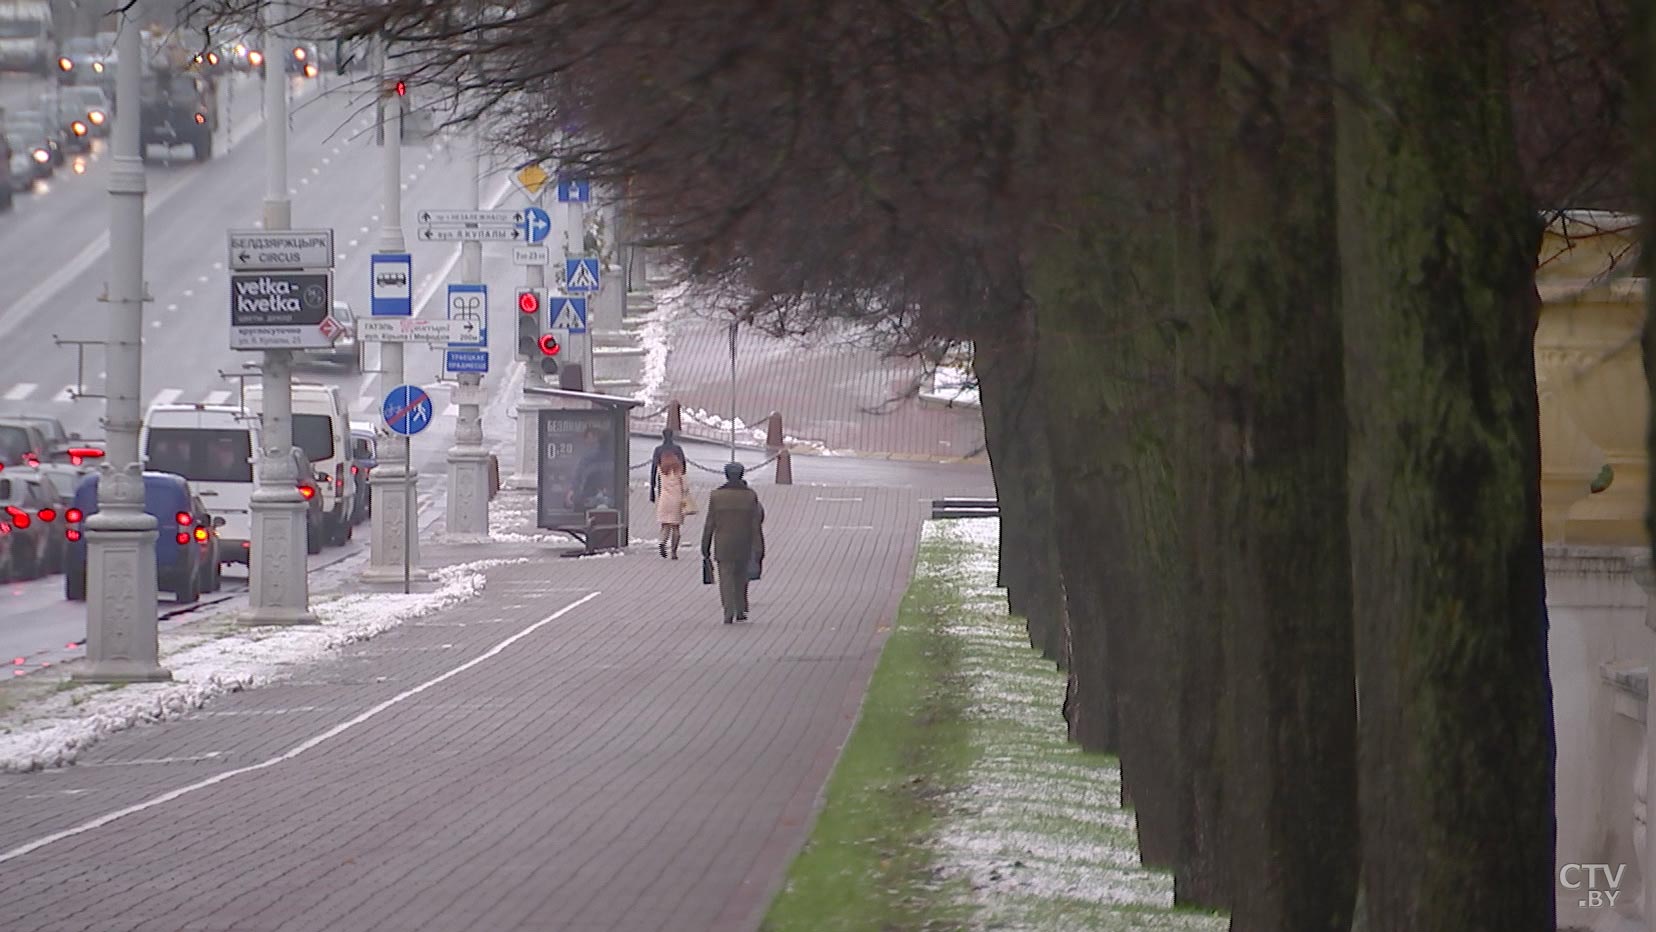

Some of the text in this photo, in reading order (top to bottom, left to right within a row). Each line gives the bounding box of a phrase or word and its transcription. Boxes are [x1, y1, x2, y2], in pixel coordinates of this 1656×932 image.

[231, 238, 326, 249] БЕЛДЗЯРЖЦЫРК
[258, 252, 301, 262] CIRCUS
[236, 277, 299, 295] vetka-
[237, 294, 302, 312] kvetka
[364, 323, 394, 331] ГАТЭЛЬ
